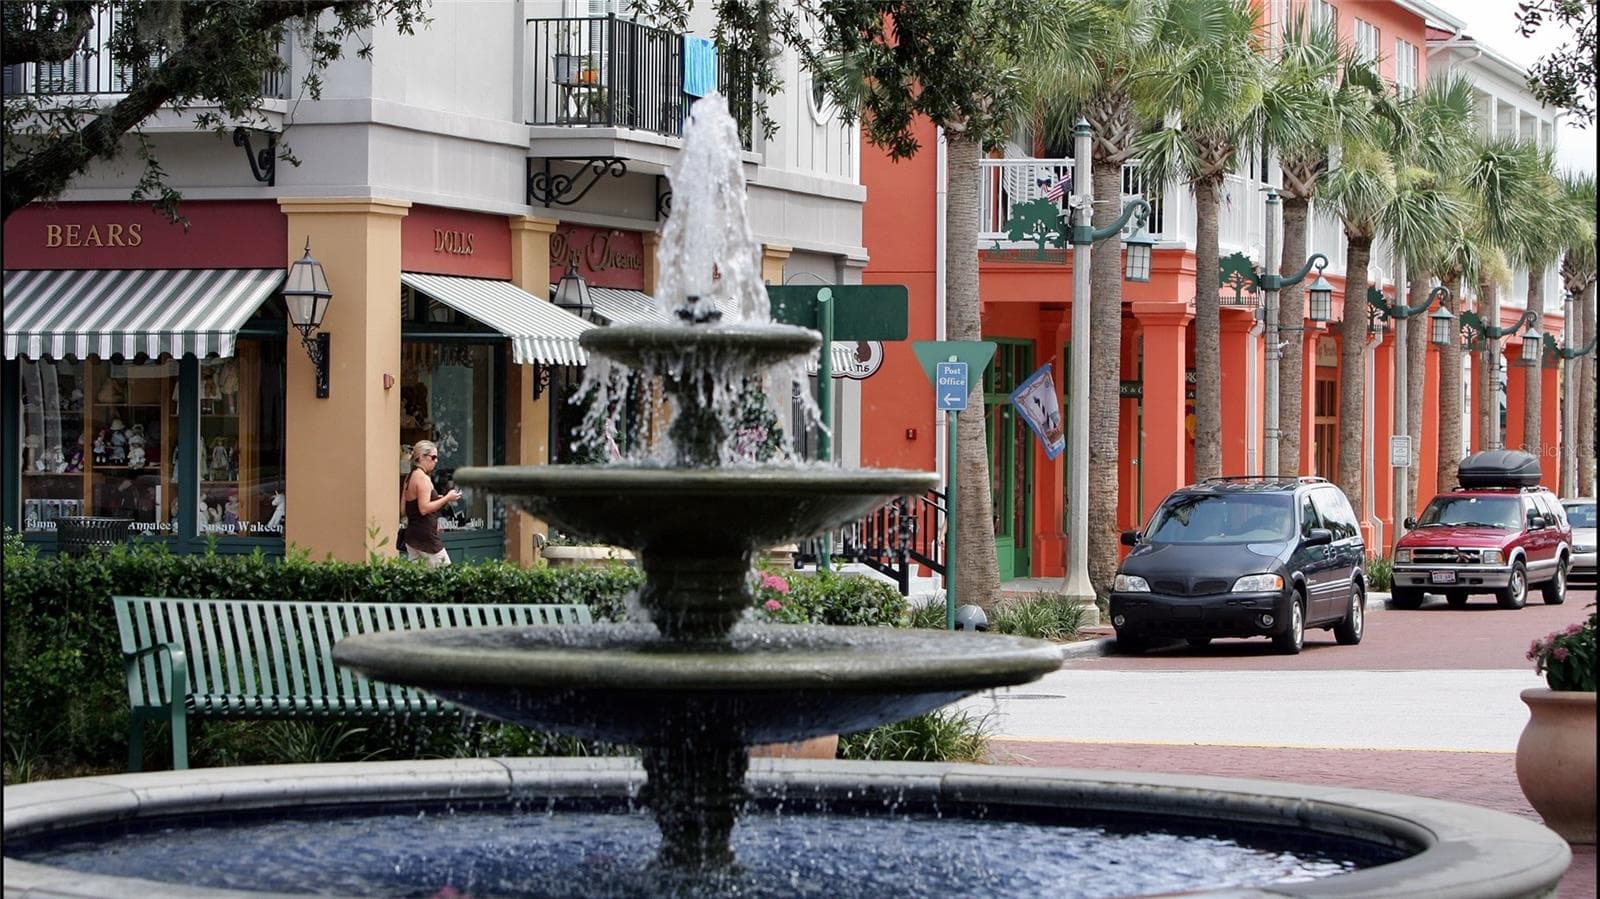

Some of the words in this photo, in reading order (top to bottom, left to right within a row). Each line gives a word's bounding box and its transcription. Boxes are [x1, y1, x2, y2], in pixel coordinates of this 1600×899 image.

[46, 223, 143, 249] BEARS
[433, 228, 474, 256] DOLLS
[944, 366, 961, 375] Post
[939, 377, 965, 386] Office
[202, 520, 235, 532] Susan
[238, 521, 283, 533] Wakeen
